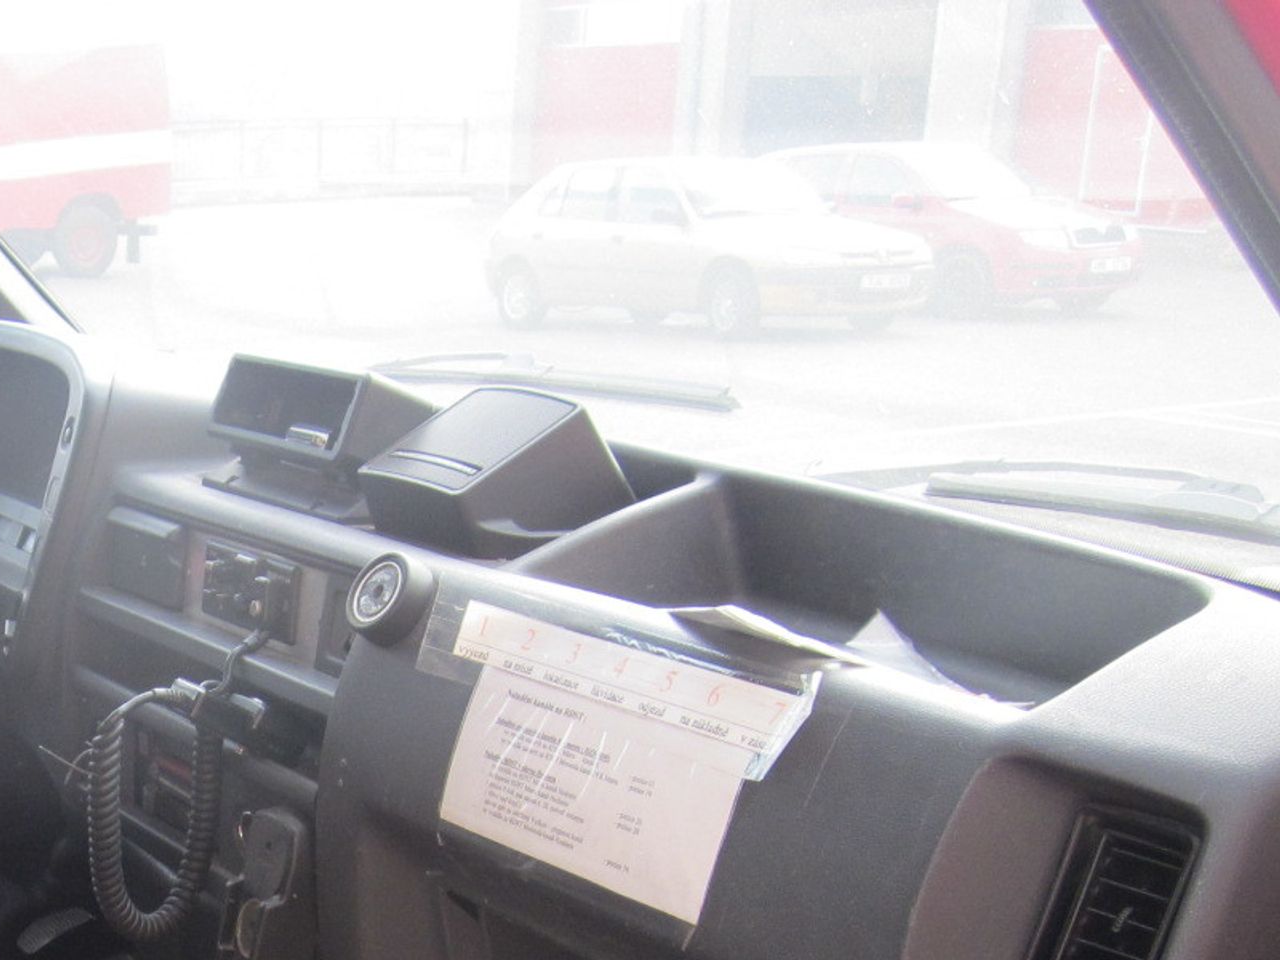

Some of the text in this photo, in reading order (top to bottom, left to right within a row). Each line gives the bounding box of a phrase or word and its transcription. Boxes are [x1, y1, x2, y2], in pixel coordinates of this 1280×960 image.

[478, 616, 489, 637] 1
[520, 628, 538, 651] 2
[566, 642, 584, 665] 3
[659, 670, 679, 693] 5
[707, 684, 723, 708] 6
[768, 701, 788, 726] 7
